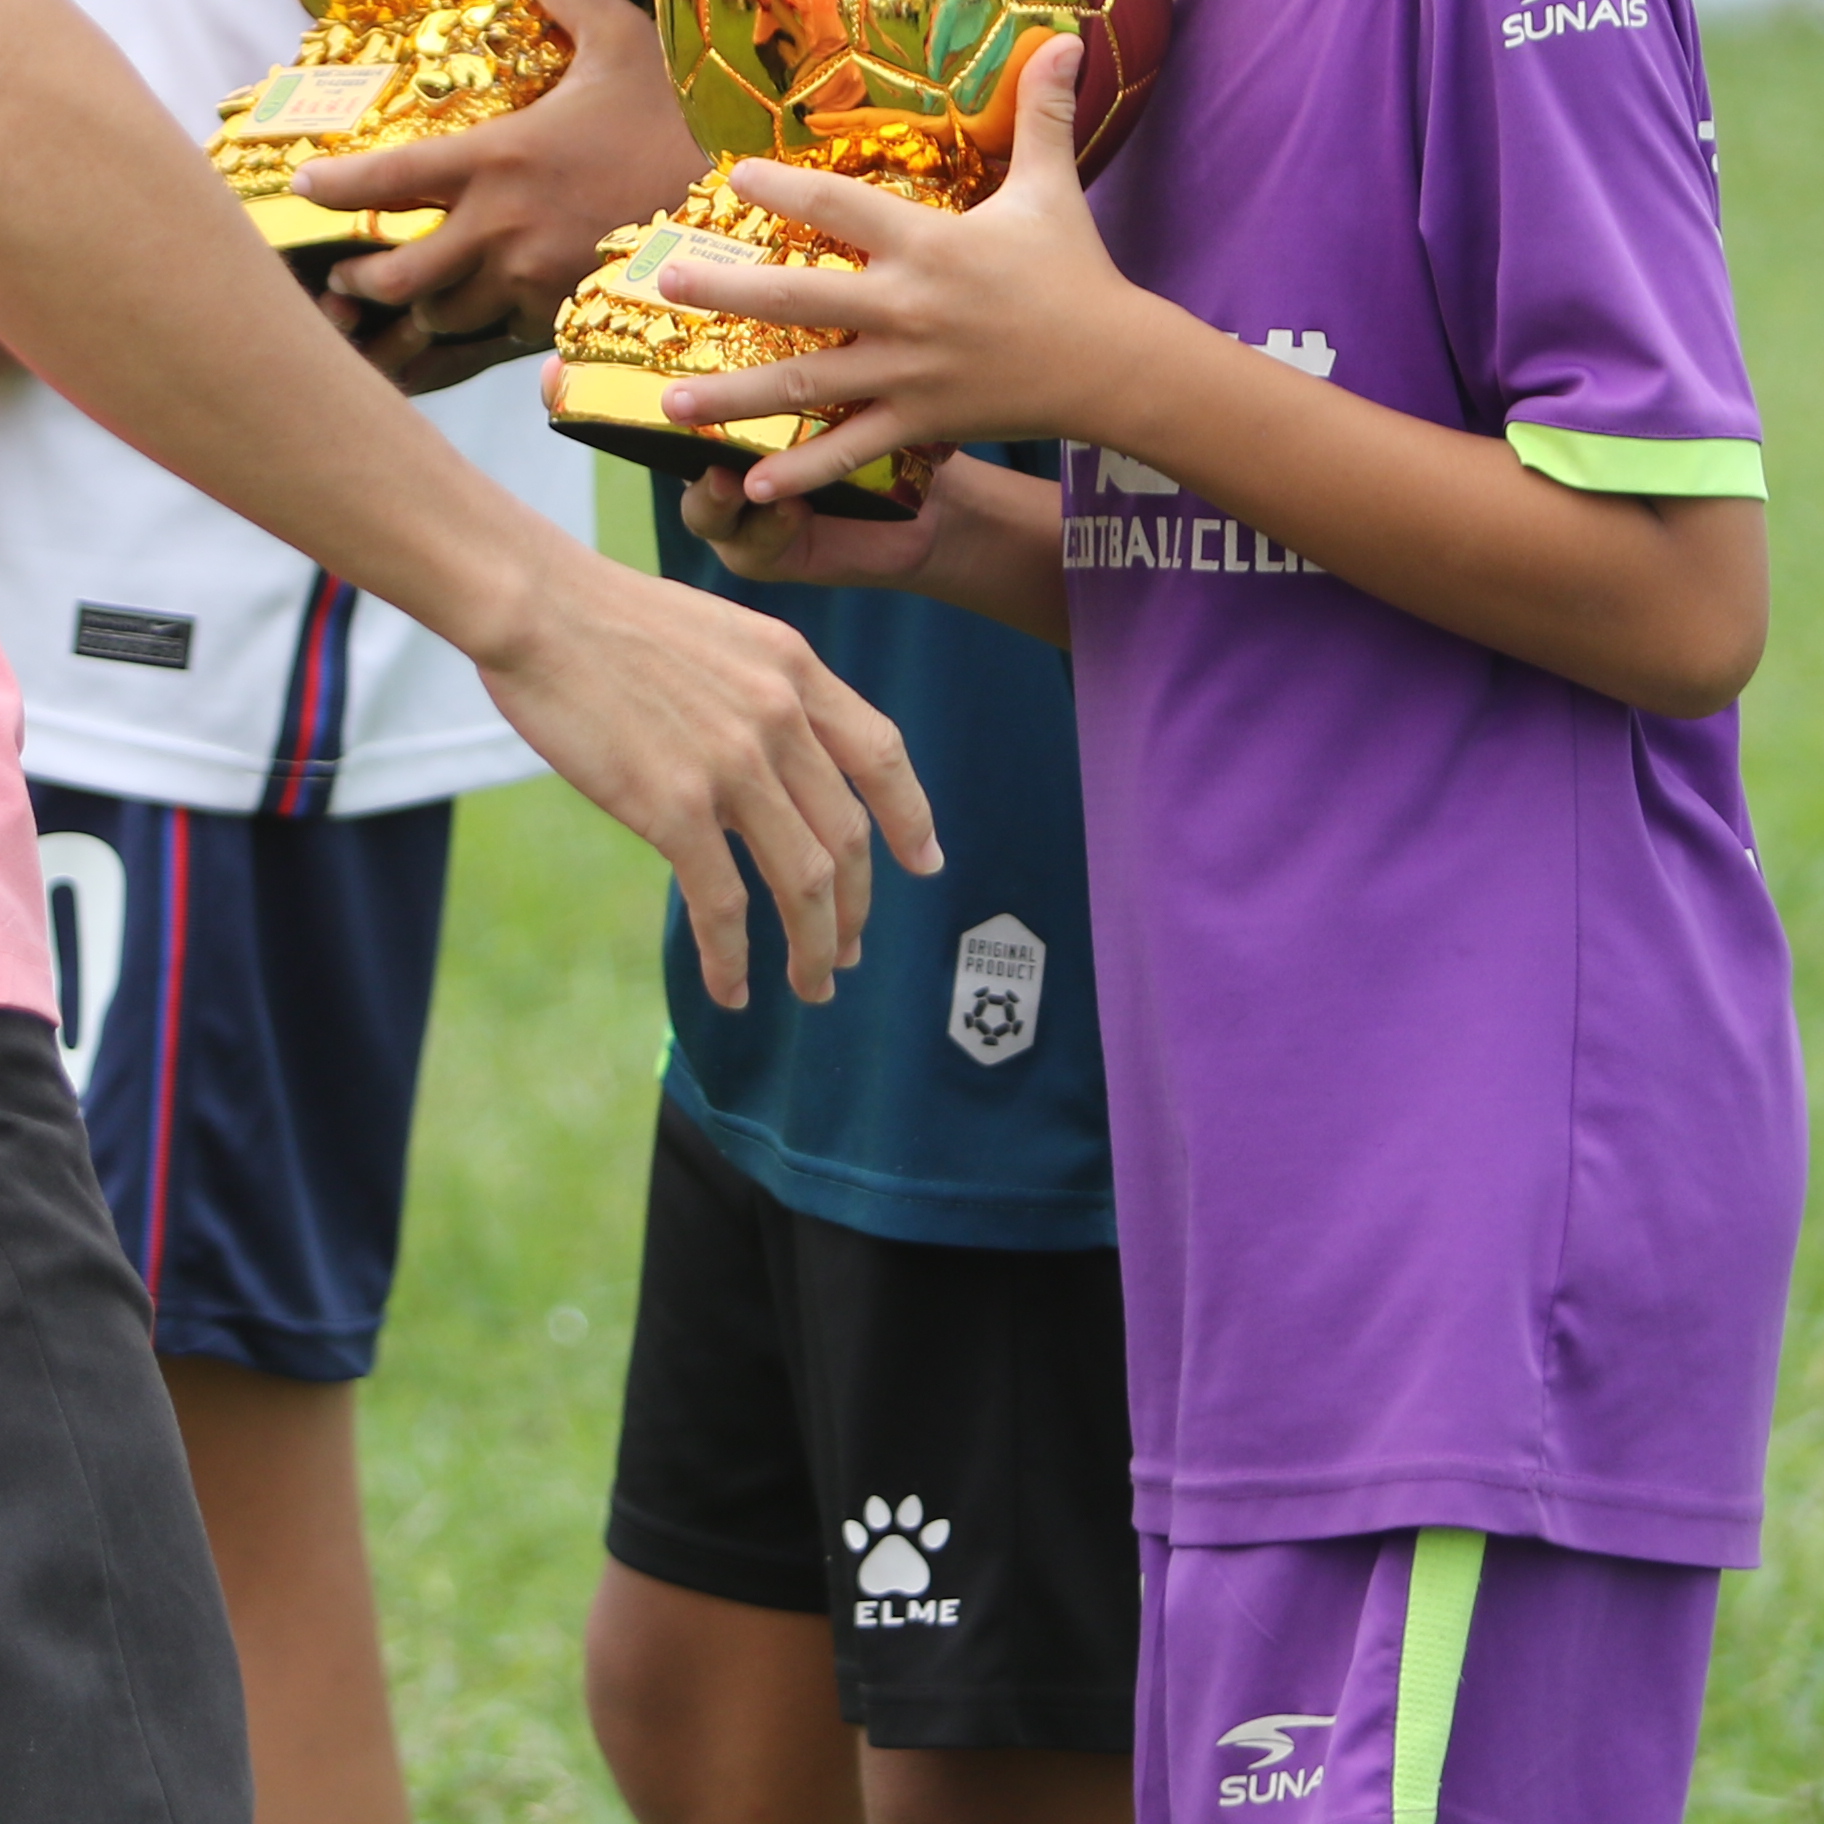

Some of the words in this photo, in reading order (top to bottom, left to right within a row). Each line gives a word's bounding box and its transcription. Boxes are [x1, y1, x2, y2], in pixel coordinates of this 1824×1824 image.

[1190, 518, 1328, 572] CLU
[967, 938, 1037, 963] ORIGINAL
[964, 956, 1037, 981] PRODUCT
[853, 1597, 962, 1628] ELME
